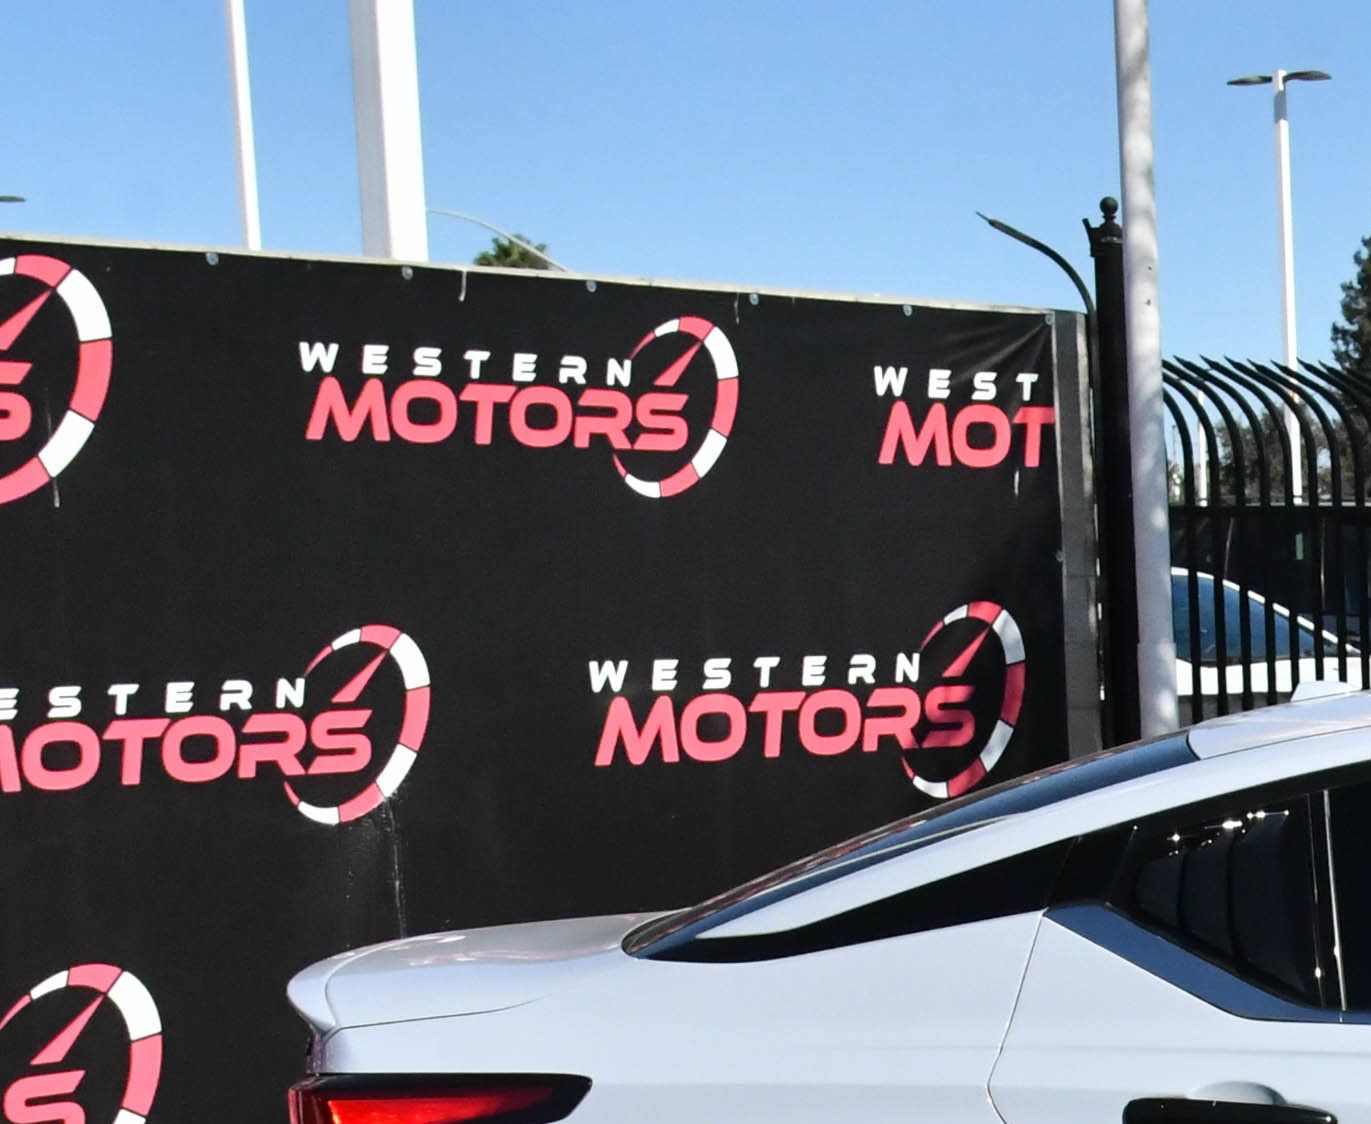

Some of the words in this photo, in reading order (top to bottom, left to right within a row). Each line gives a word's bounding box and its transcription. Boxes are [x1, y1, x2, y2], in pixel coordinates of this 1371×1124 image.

[299, 342, 632, 387] WESTERN
[874, 366, 1038, 401] WEST
[305, 376, 690, 451] MOTORS
[878, 401, 1056, 468] MOT
[588, 653, 921, 693] WESTERN
[0, 710, 373, 793] OTORS
[594, 685, 976, 766] MOTORS
